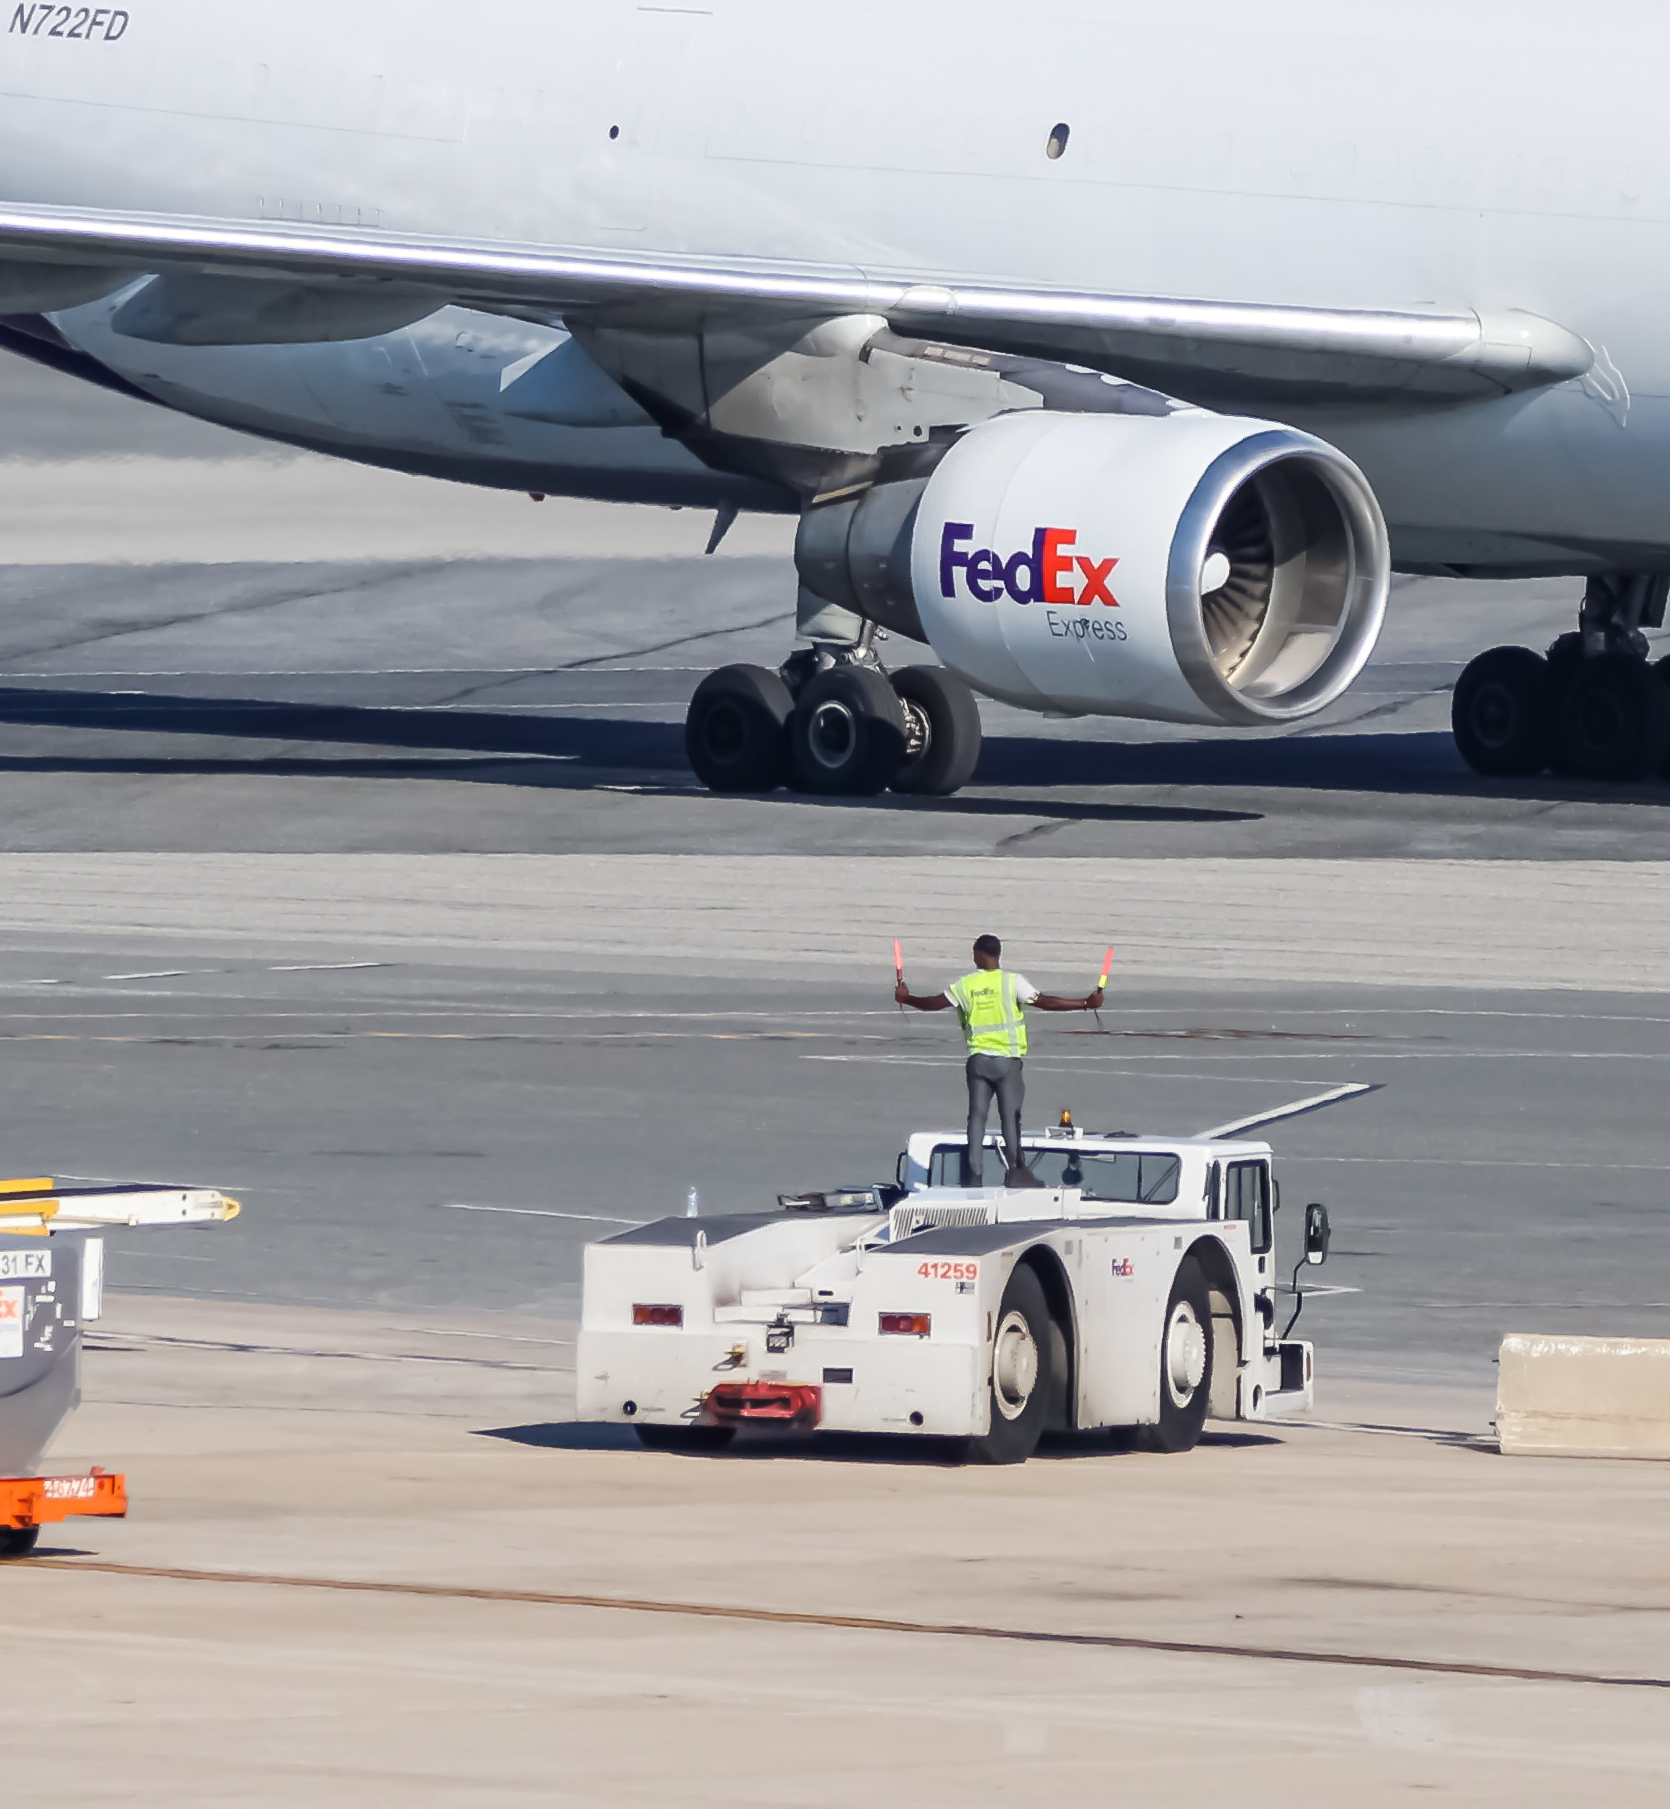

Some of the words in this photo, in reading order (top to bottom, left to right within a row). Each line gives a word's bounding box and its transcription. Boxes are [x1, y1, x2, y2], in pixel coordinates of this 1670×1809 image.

[8, 2, 129, 41] N722FD
[940, 522, 1120, 607] FedEx
[1046, 610, 1129, 642] Express
[25, 1254, 47, 1274] FX
[917, 1261, 977, 1279] 41259
